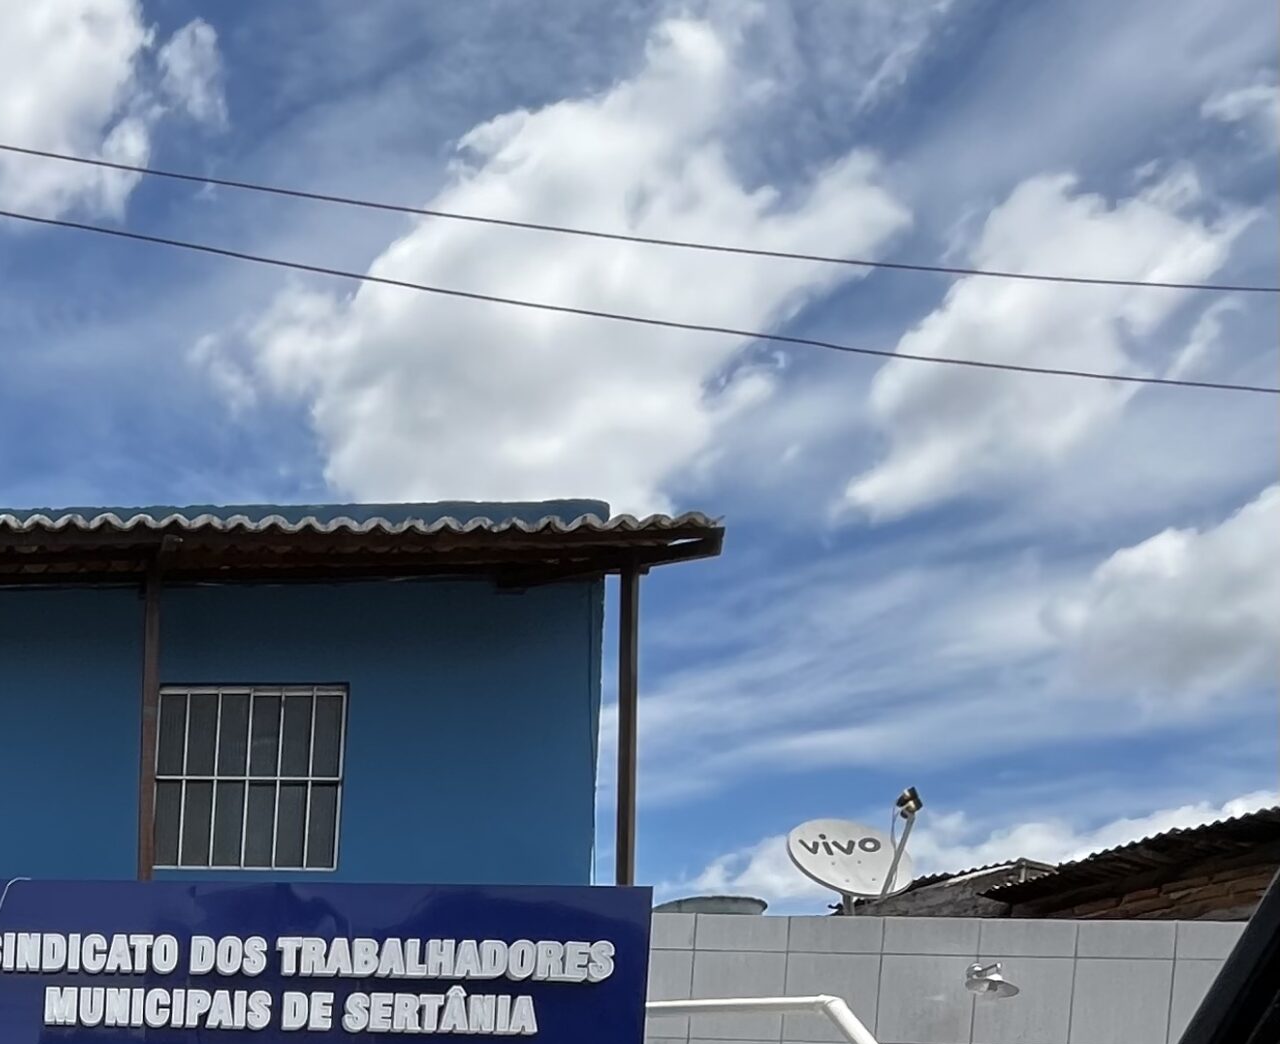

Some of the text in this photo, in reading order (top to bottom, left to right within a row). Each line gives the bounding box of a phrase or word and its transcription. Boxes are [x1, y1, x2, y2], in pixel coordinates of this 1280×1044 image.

[798, 833, 881, 856] vivo
[189, 935, 268, 976] DOS
[276, 936, 616, 982] TRABALHADORES
[44, 985, 538, 1035] MUNICIPAIS DE SERTÂNIA
